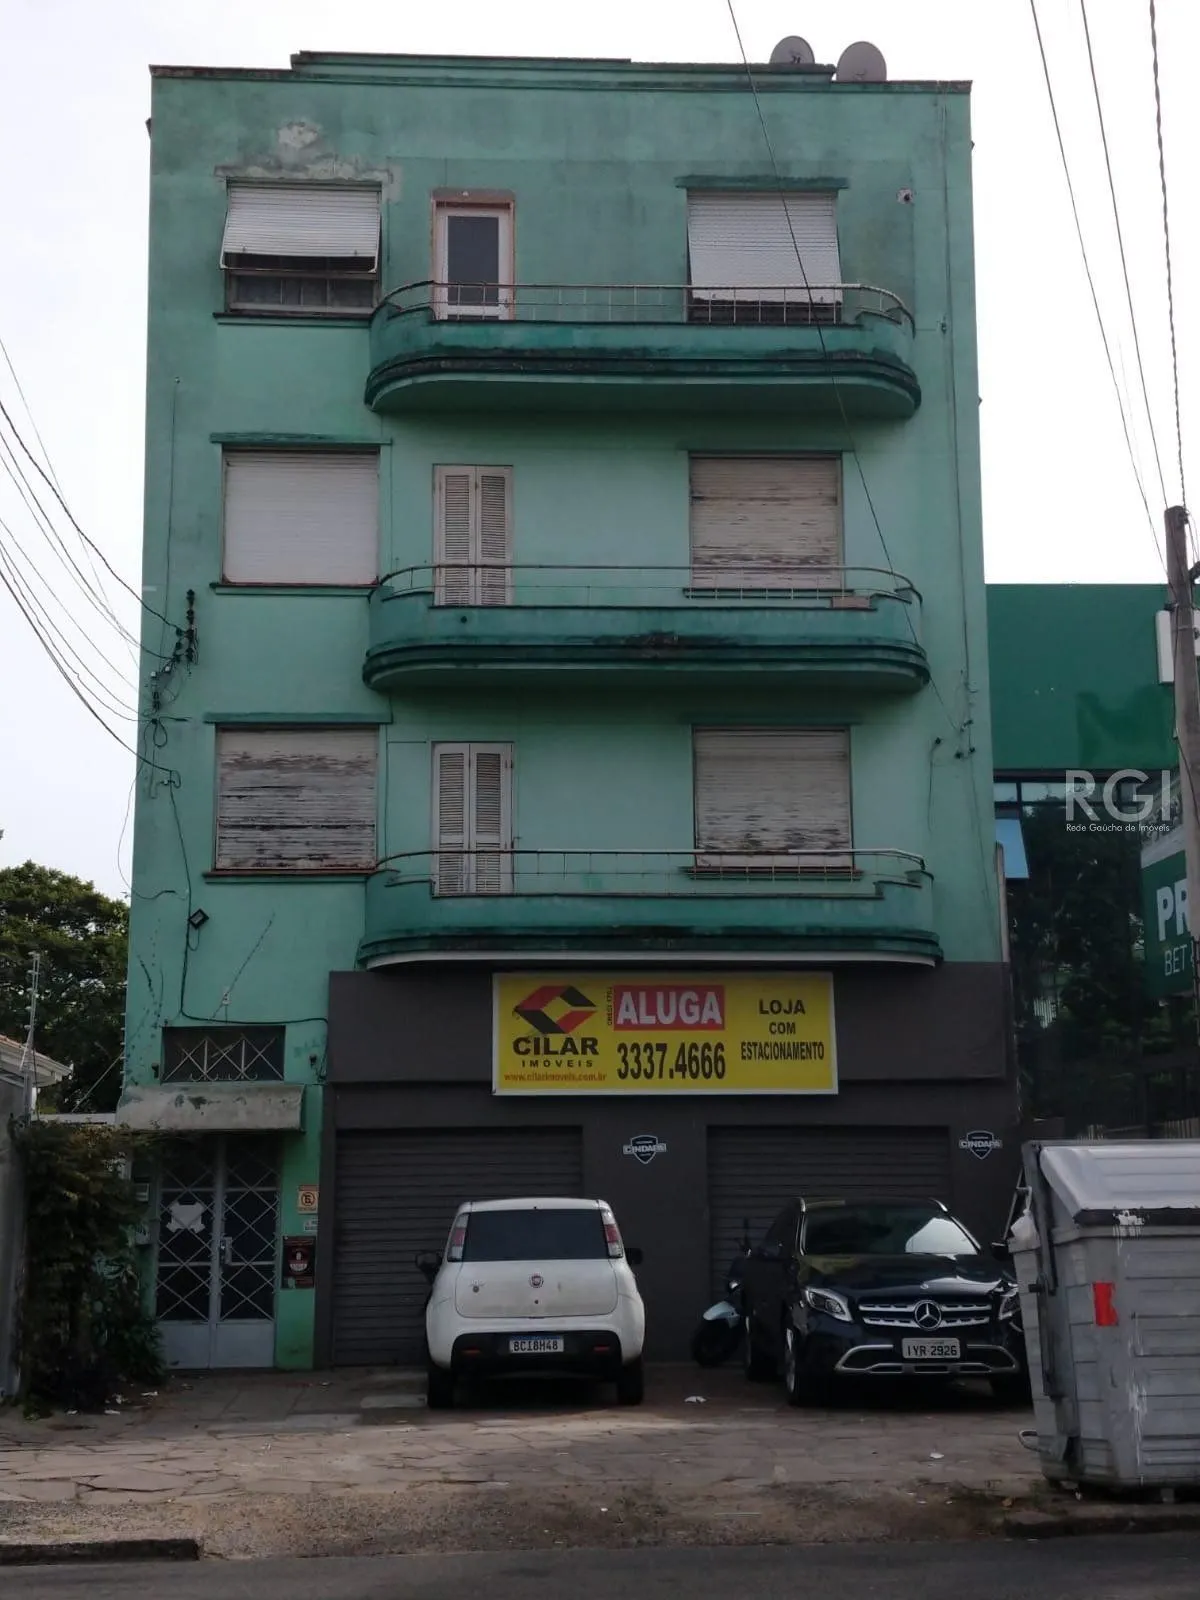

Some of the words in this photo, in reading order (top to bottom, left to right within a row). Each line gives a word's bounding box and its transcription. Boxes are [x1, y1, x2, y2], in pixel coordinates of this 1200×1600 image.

[616, 991, 723, 1025] ALUGA
[759, 999, 806, 1015] LOJA
[769, 1022, 796, 1035] COM
[512, 1036, 599, 1056] CILAR
[740, 1041, 825, 1061] ESTACIONAMENTO
[616, 1042, 726, 1080] 3337.4666
